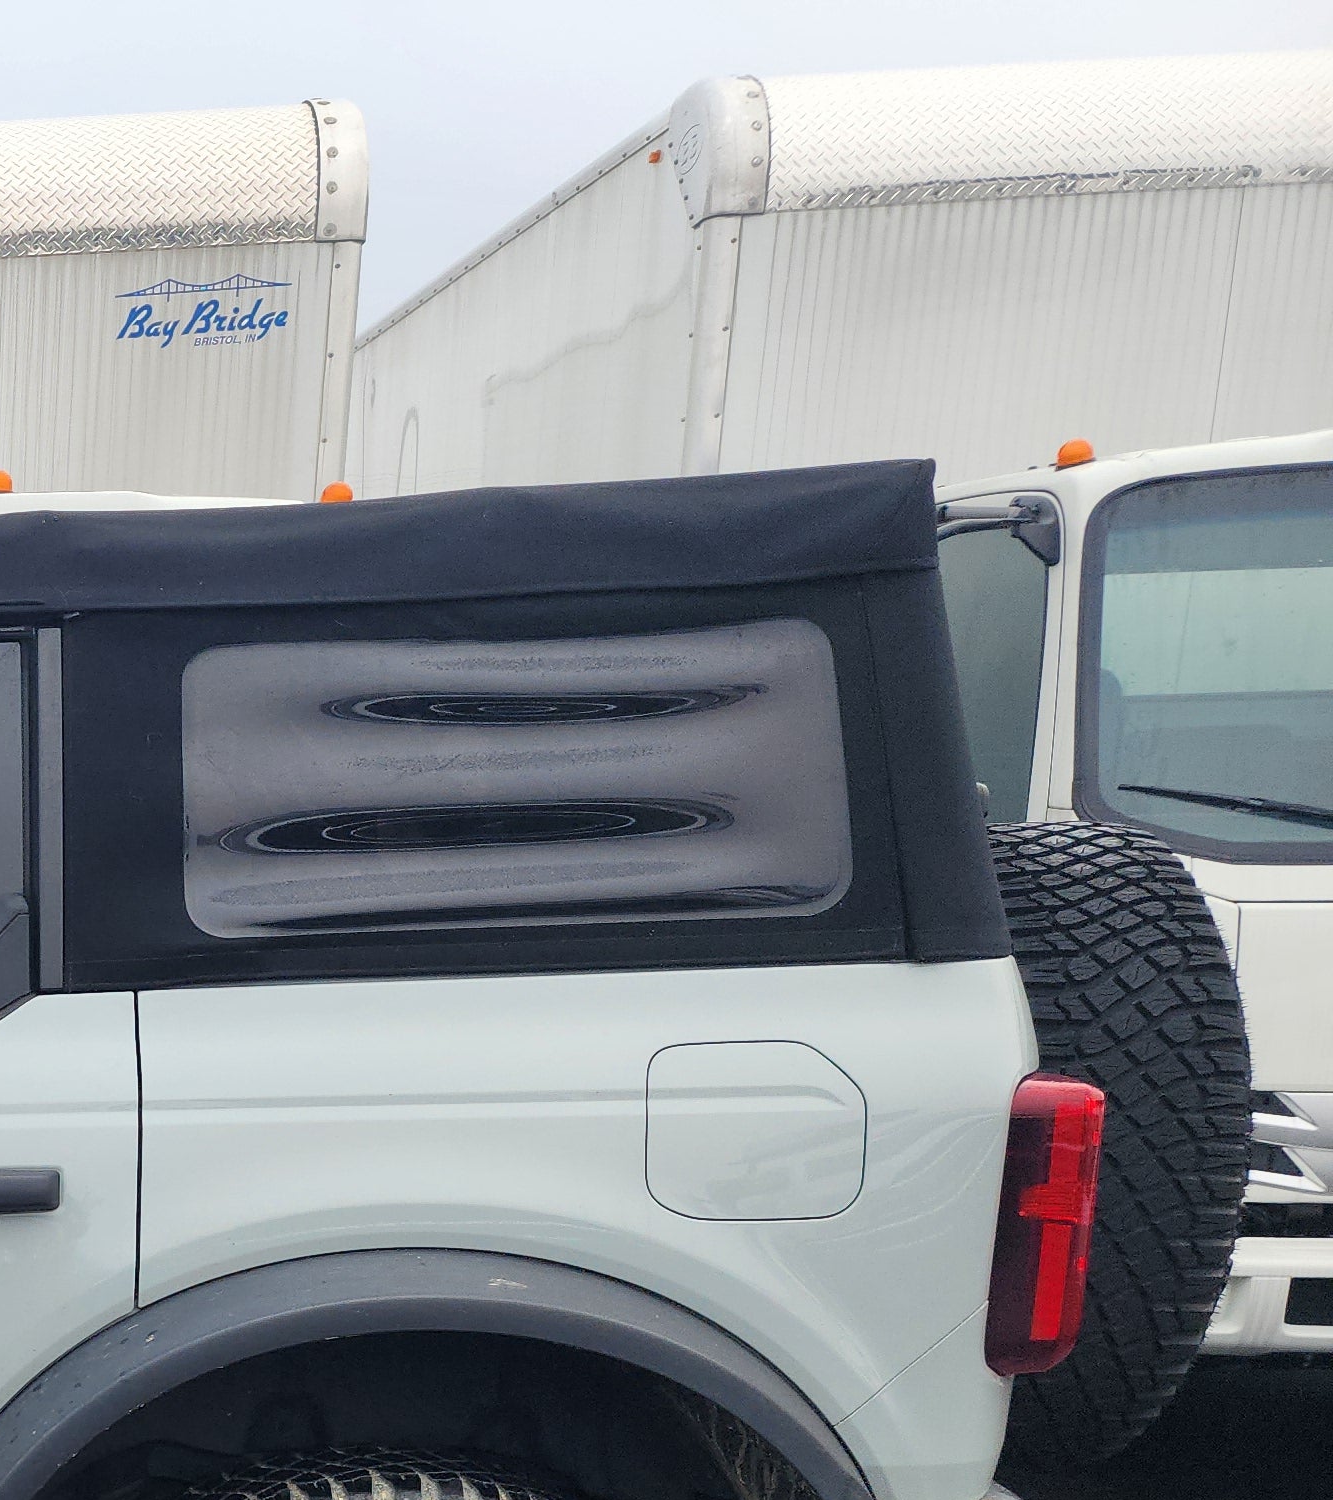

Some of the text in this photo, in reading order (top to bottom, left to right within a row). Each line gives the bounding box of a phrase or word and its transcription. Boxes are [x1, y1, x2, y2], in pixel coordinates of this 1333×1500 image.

[116, 298, 289, 348] Bay Bridge
[194, 335, 257, 346] BRISTOL, IN
